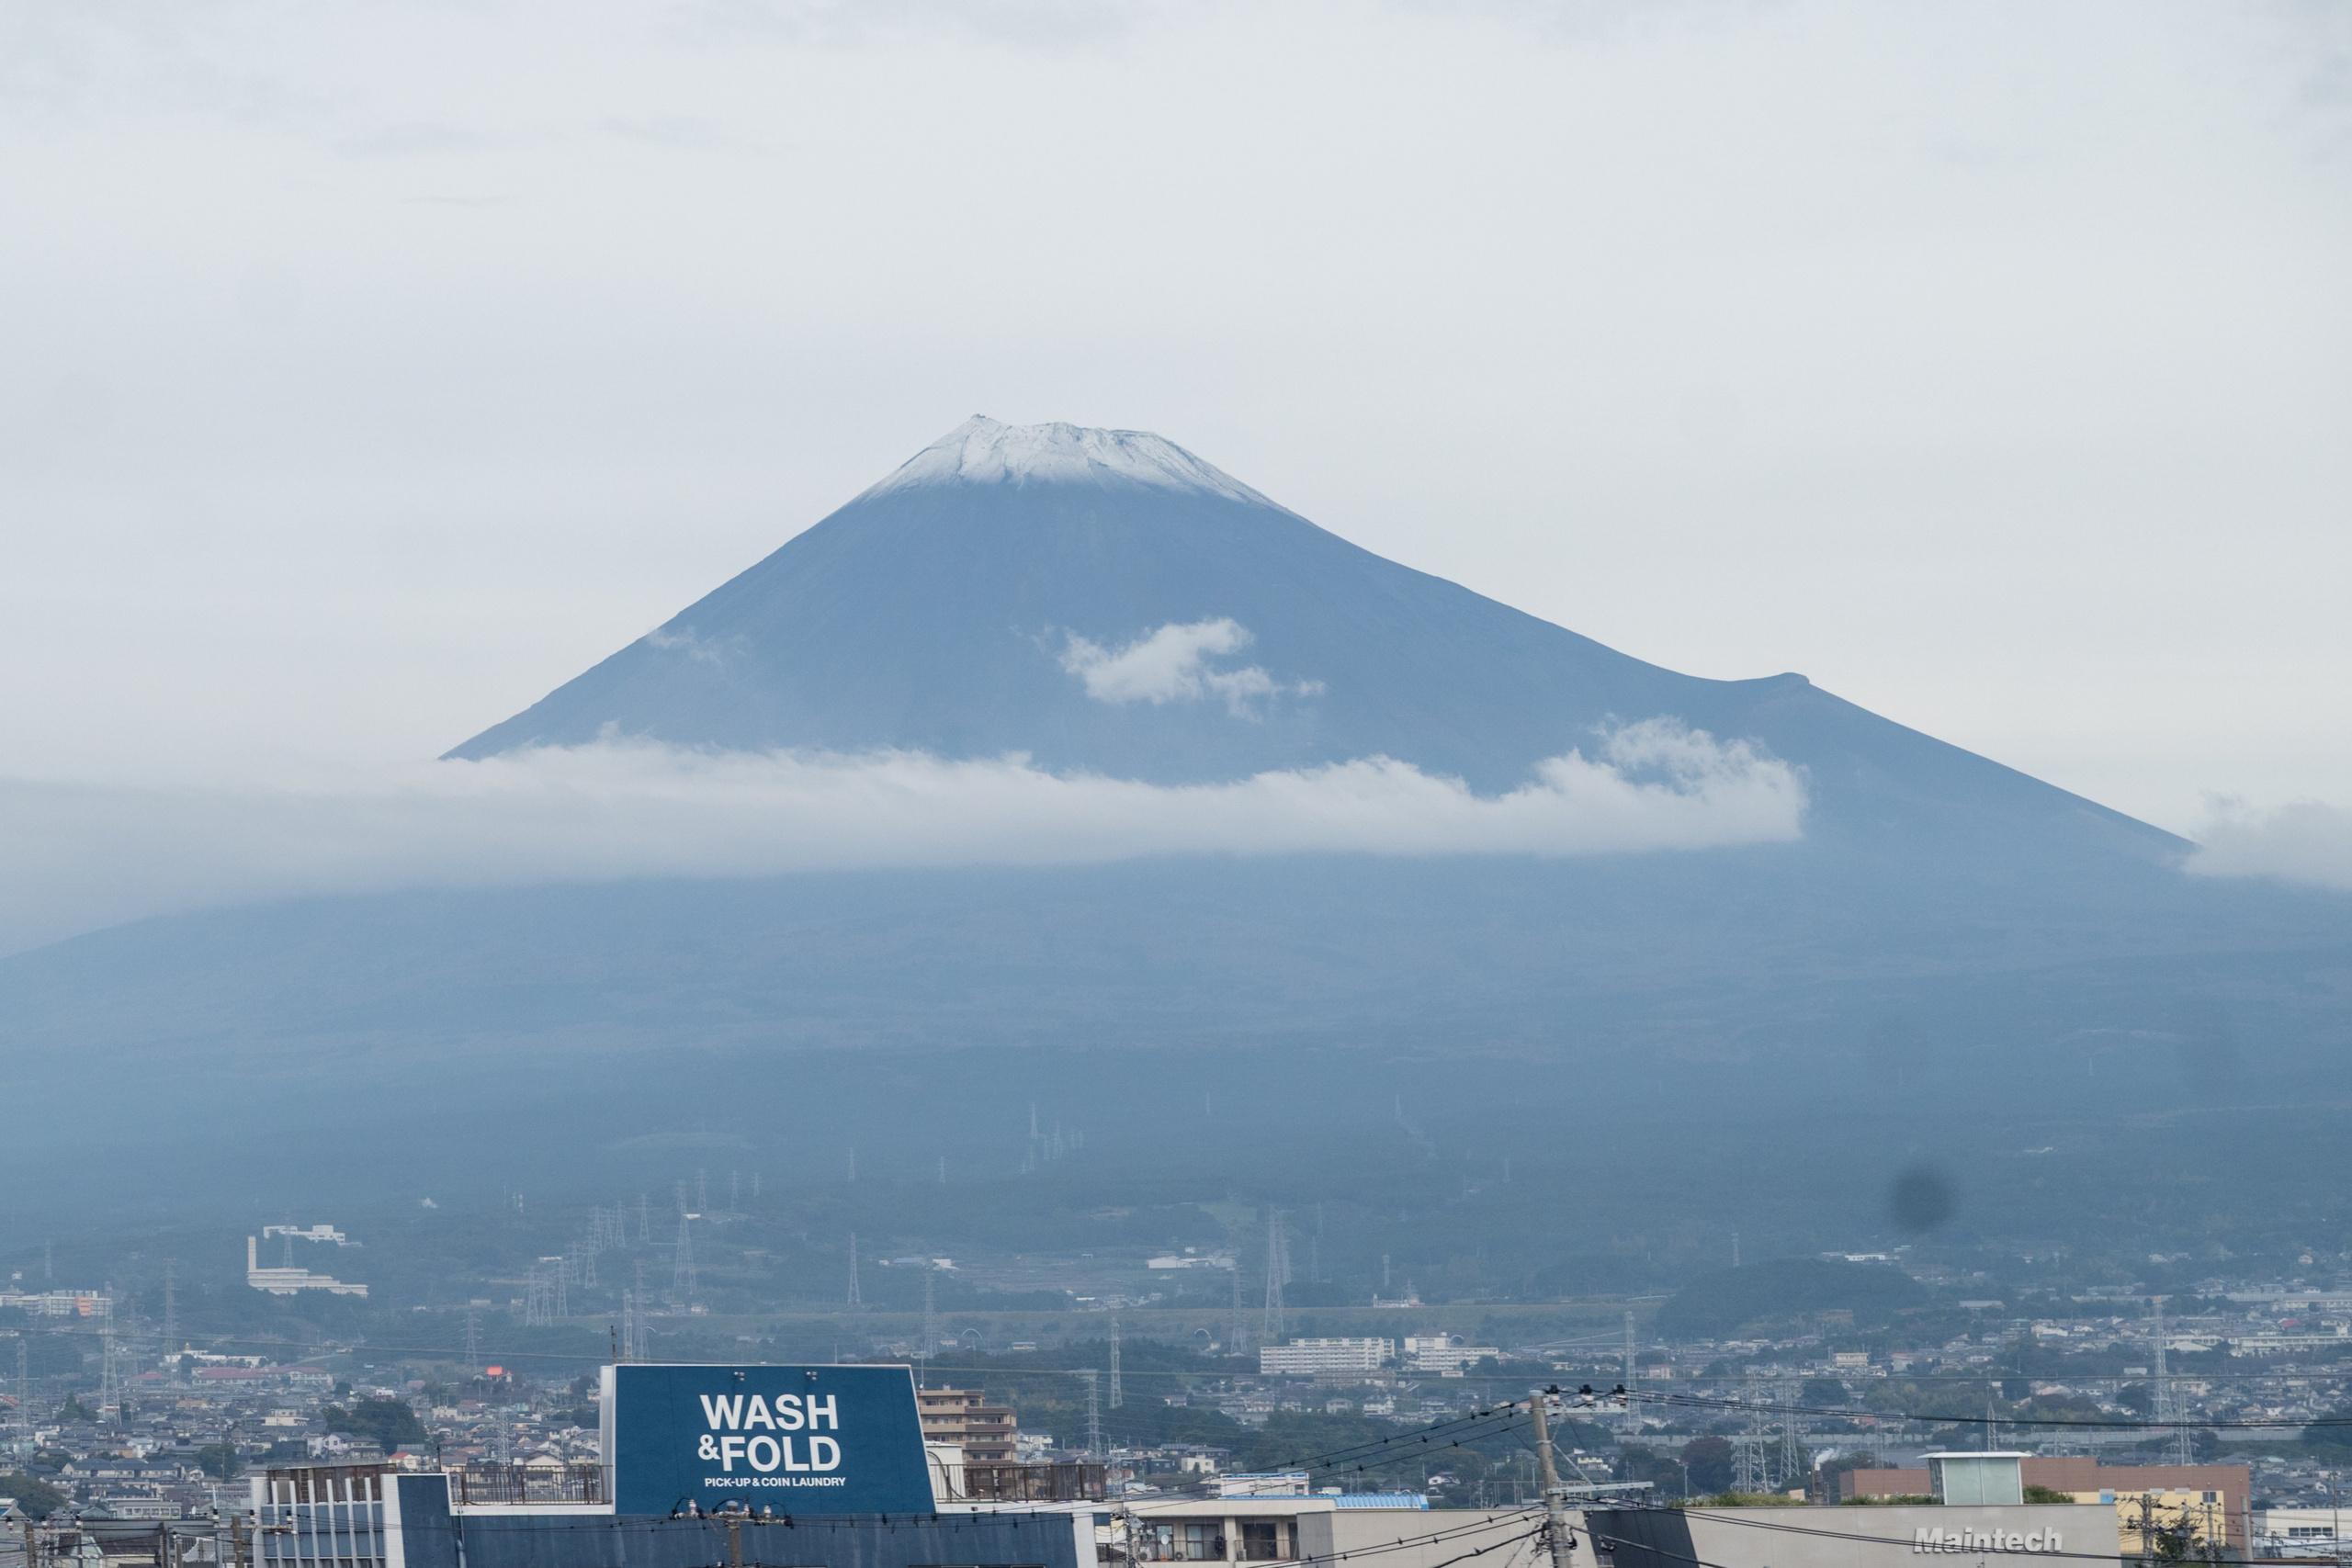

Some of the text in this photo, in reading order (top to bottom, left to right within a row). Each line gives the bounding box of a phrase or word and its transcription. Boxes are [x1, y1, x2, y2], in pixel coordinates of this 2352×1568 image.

[699, 1393, 839, 1430] WASH
[705, 1477, 846, 1487] PICK-UP & COIN LAUNDRY
[1913, 1527, 2063, 1554] Maintech
